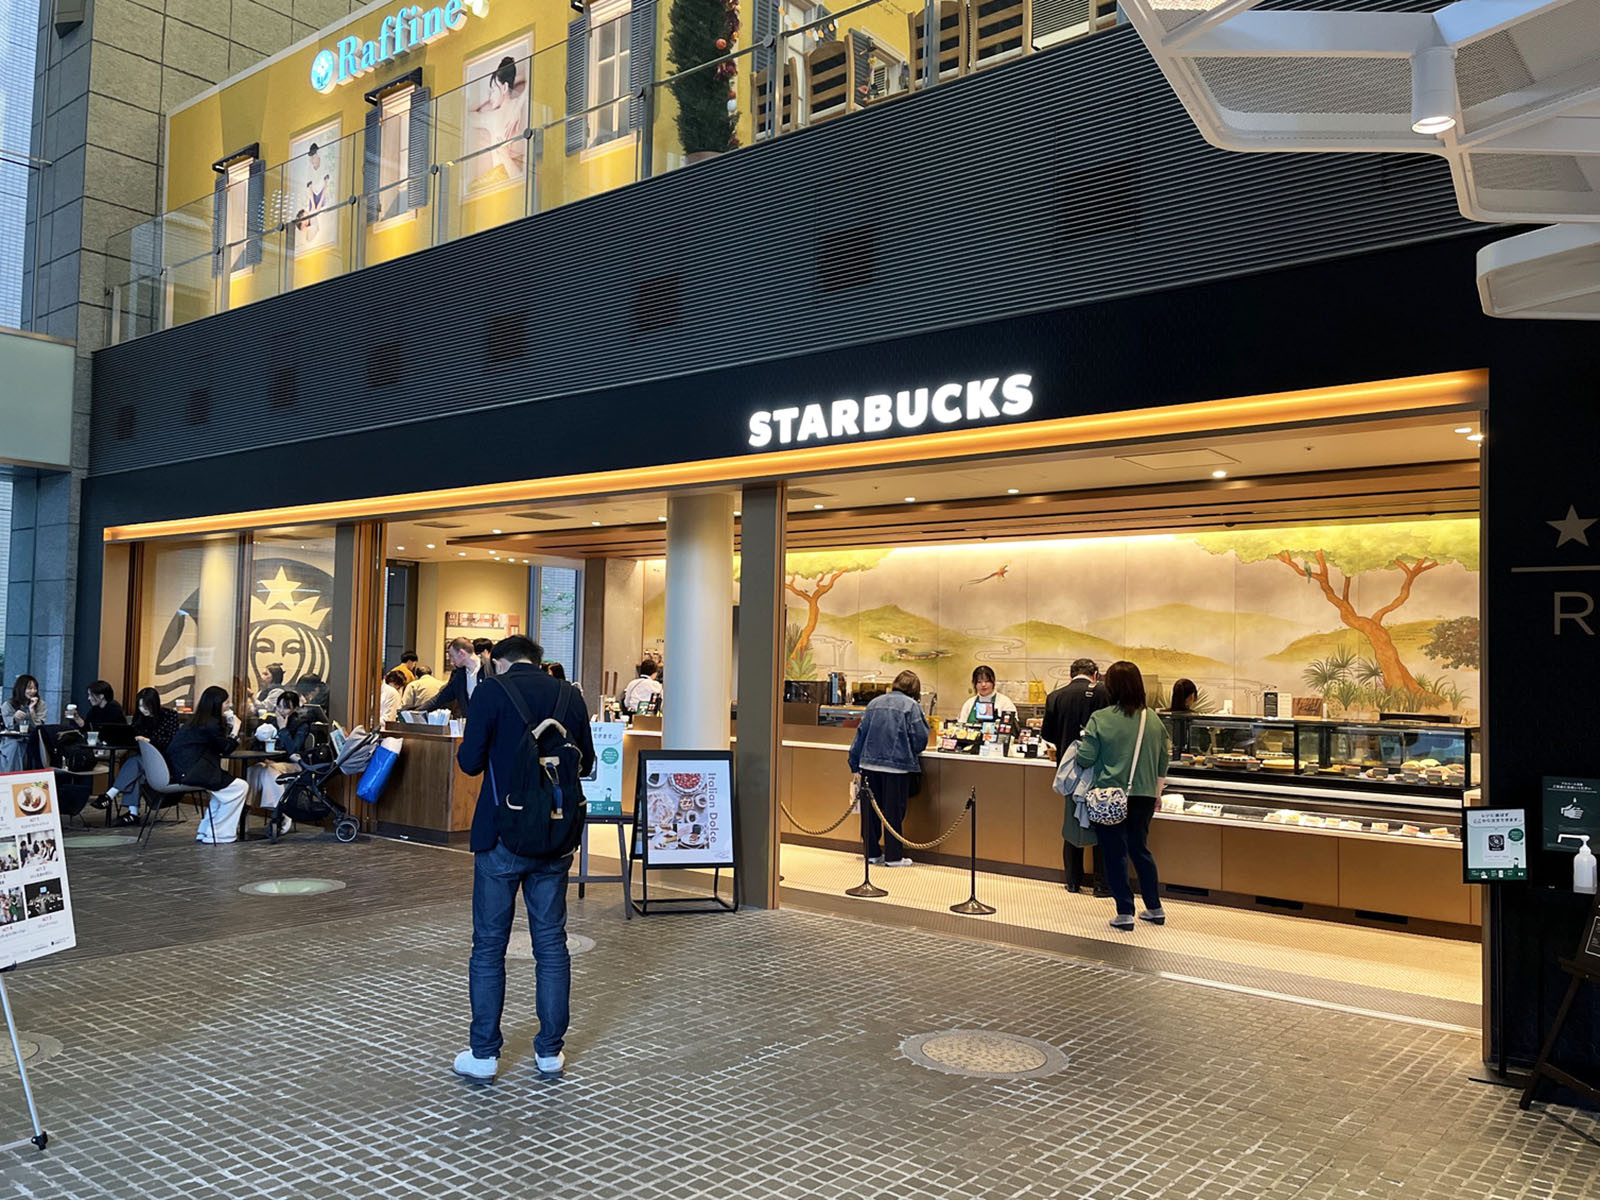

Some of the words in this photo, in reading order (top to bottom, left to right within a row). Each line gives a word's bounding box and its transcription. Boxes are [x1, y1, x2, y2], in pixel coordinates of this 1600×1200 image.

[336, 0, 462, 82] Raffine
[748, 373, 1034, 447] STARBUCKS
[1554, 591, 1595, 636] R
[708, 773, 718, 808] Italian
[709, 812, 719, 843] Dolce
